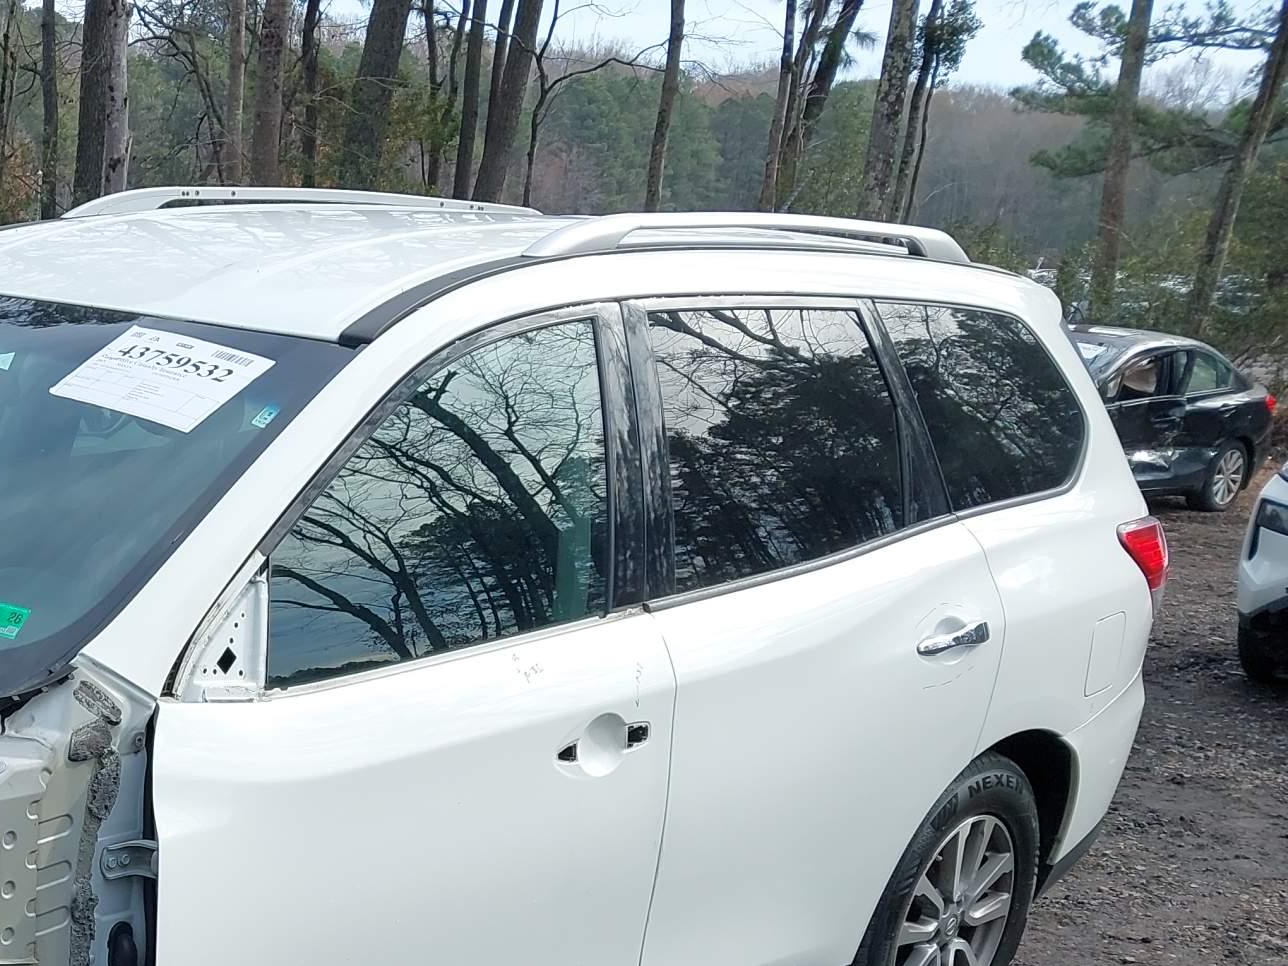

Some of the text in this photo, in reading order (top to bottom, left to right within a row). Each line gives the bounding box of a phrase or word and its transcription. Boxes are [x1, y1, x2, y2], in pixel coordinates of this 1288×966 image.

[117, 344, 234, 383] 43759532
[7, 612, 24, 625] 26
[967, 773, 1024, 797] NEXEN
